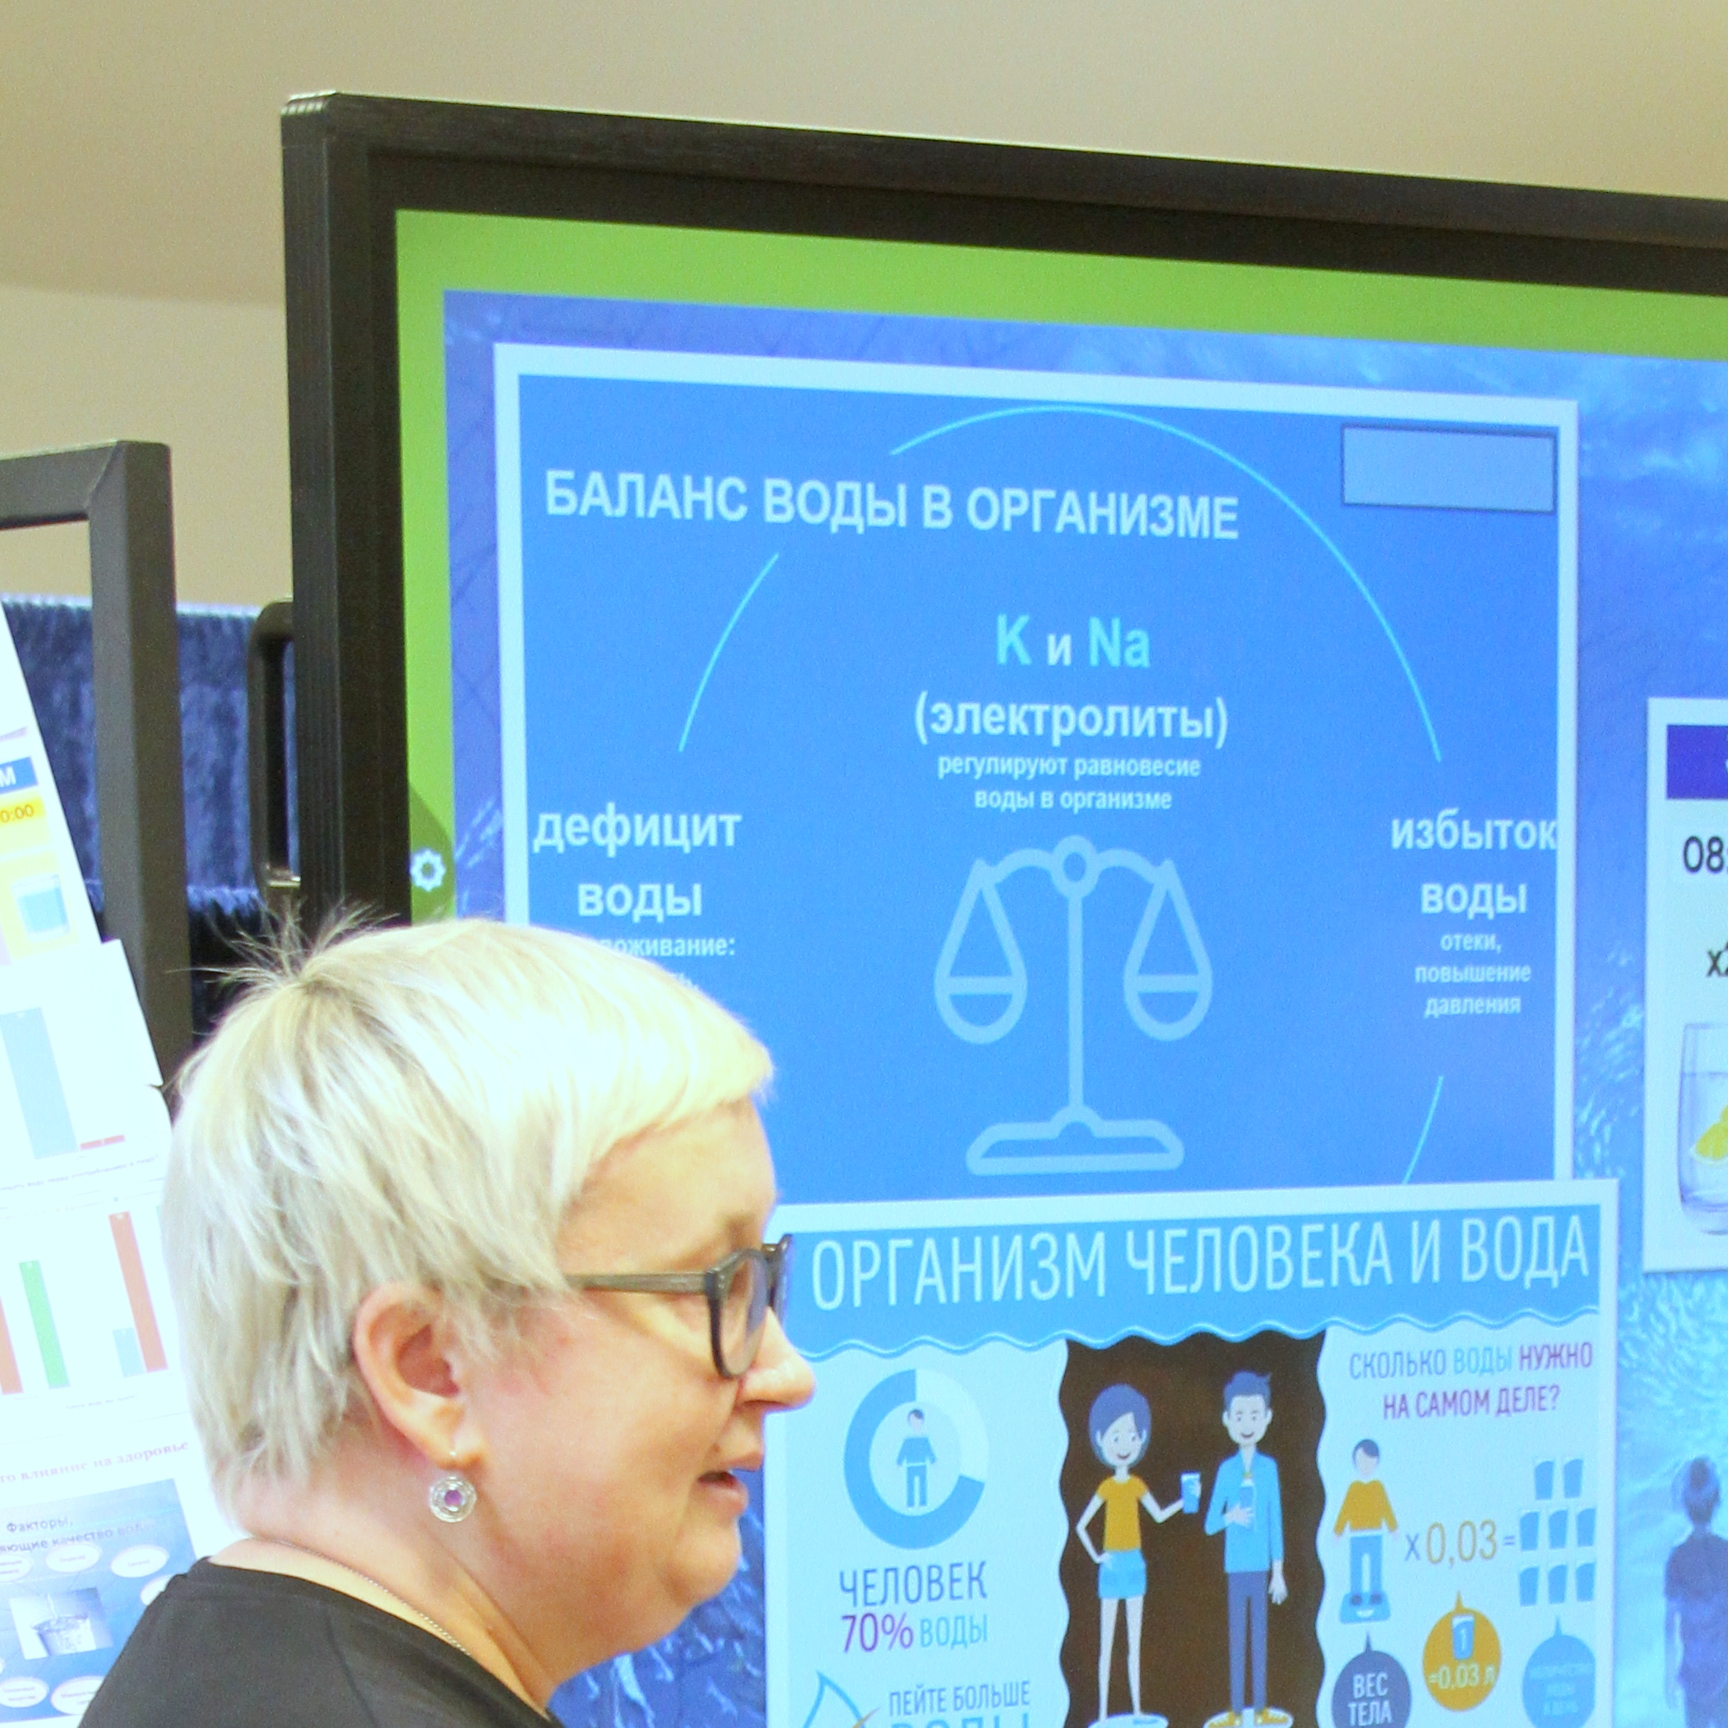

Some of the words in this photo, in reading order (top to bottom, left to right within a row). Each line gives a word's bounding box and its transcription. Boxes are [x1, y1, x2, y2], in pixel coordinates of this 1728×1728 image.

[545, 469, 749, 522] БАЛАНС
[762, 476, 908, 534] ВОДЫ
[922, 484, 954, 530] В
[966, 486, 1239, 541] ОРГАНИЗМЕ
[1047, 633, 1072, 667] и
[1089, 616, 1150, 668] Na
[915, 690, 1229, 750] (электролиты)
[938, 755, 1068, 781] регулируют
[1074, 757, 1201, 781] равновесие
[974, 789, 1034, 814] воды
[1040, 791, 1054, 809] в
[1060, 790, 1173, 815] организме
[532, 801, 743, 858] дефицит
[1391, 809, 1557, 852] избыток
[577, 883, 703, 923] воды
[1419, 879, 1528, 920] воды
[1440, 930, 1502, 955] отеки,
[1414, 959, 1531, 985] повышение
[1423, 992, 1521, 1018] давления
[811, 1231, 1107, 1312] ОРГАНИЗМ
[1125, 1218, 1395, 1298] ЧЕЛОВЕКА
[1410, 1222, 1441, 1285] И
[1461, 1213, 1590, 1288] ВОДА
[1350, 1348, 1447, 1380] СКОЛЬКО
[1453, 1346, 1512, 1377] ВОДЫ
[1518, 1341, 1594, 1372] НУЖНО
[1383, 1393, 1409, 1420] НА
[1415, 1388, 1491, 1419] САМОМ
[1494, 1383, 1561, 1418] ДЕЛЕ?
[116, 1441, 190, 1464] здоровье
[1426, 1519, 1498, 1569] 0,03
[840, 1560, 988, 1608] ЧЕЛОВЕК
[841, 1612, 914, 1653] 70%
[920, 1614, 988, 1649] ВОДЫ
[889, 1683, 947, 1717] ПЕЙТЕ
[953, 1680, 1031, 1712] БОЛЬШЕ
[1352, 1673, 1388, 1699] ВЕС
[1348, 1701, 1393, 1727] ТЕЛА
